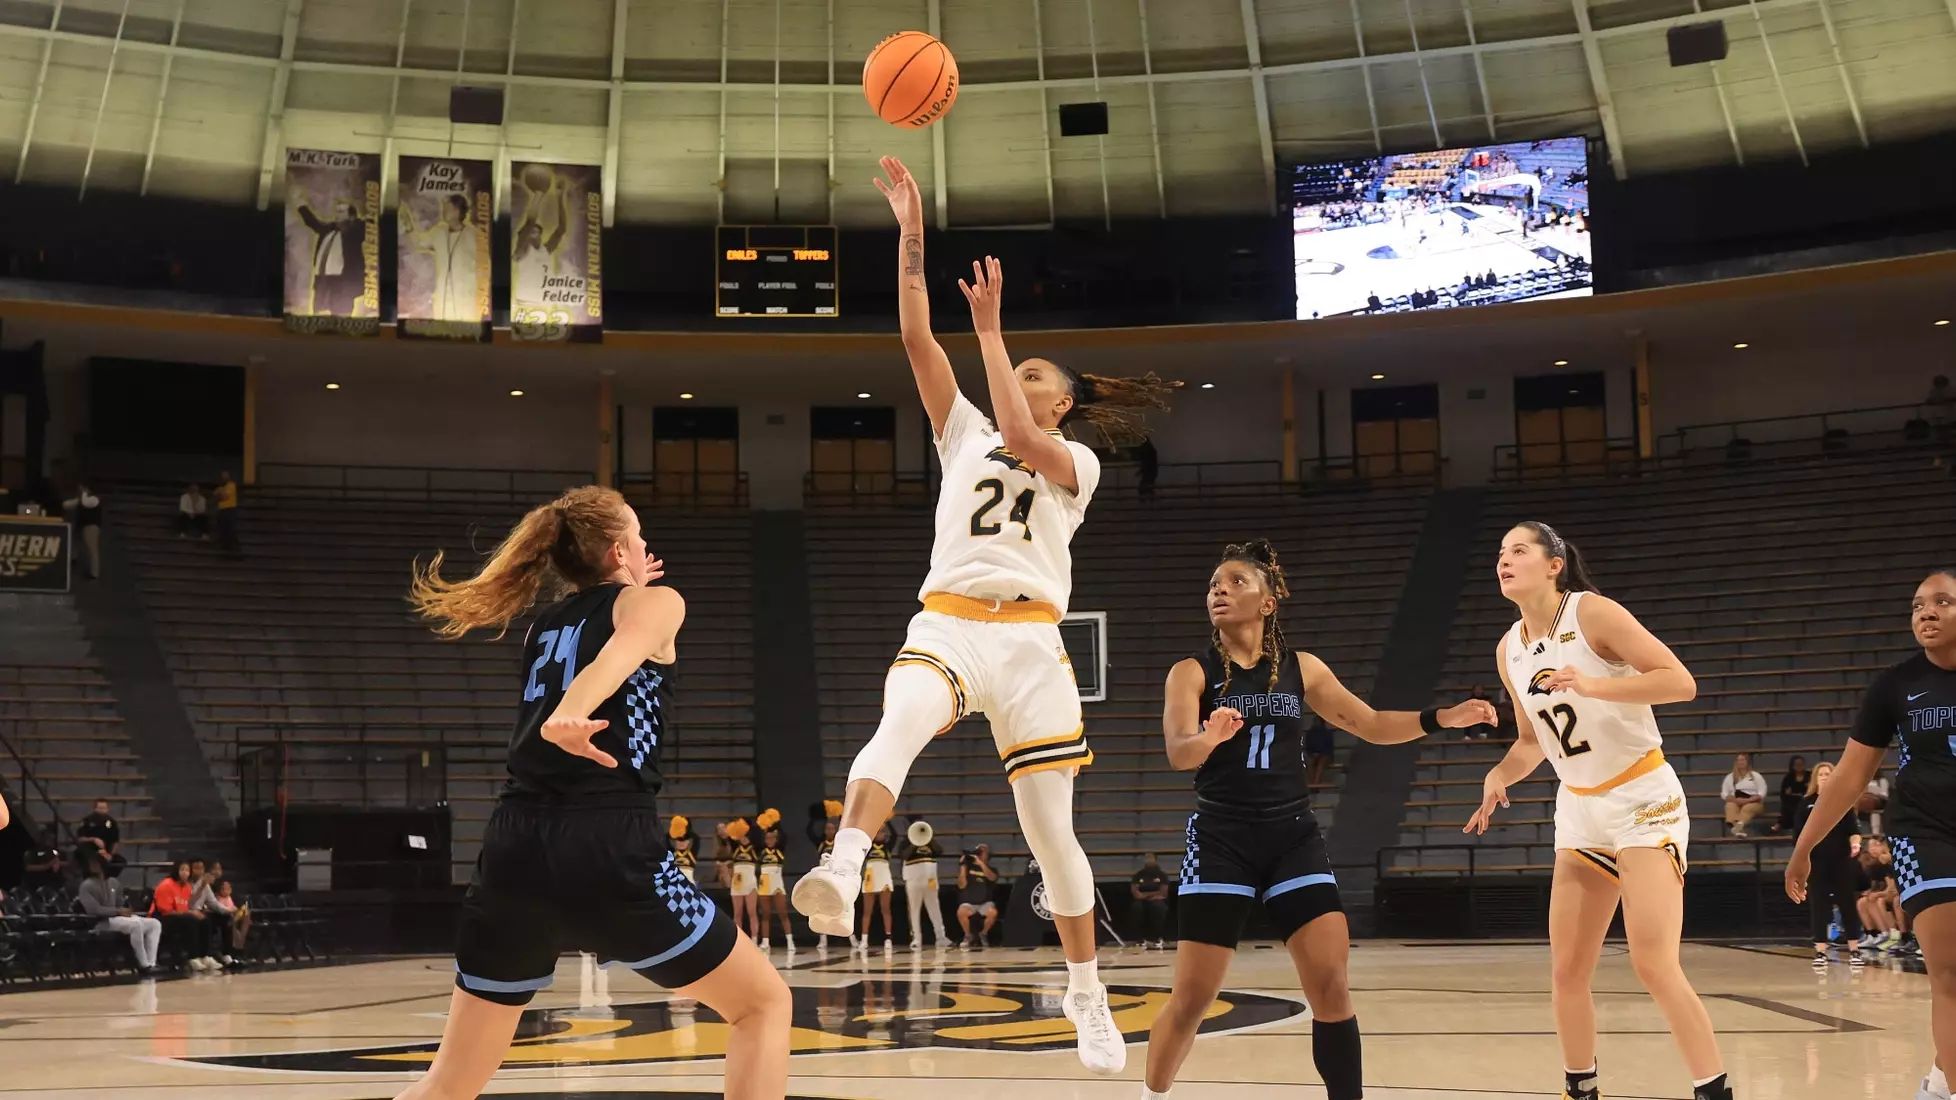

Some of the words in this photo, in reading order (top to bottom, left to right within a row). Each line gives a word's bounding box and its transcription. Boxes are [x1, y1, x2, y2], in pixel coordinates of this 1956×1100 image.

[909, 75, 955, 126] Wilson
[326, 155, 356, 167] Turk
[429, 164, 460, 181] Kay
[420, 178, 465, 193] James
[364, 180, 379, 267] SOUTHERN
[587, 192, 600, 275] SOUTHERN
[726, 249, 758, 261] EAGLES
[793, 249, 830, 261] TOPPERS
[364, 269, 378, 309] MISS
[541, 276, 583, 289] Janice
[542, 291, 584, 303] Felder
[587, 279, 600, 317] MISS
[513, 310, 570, 341] #33
[969, 478, 1036, 542] 24
[523, 618, 587, 702] 24
[1246, 724, 1276, 769] 11
[1537, 703, 1593, 759] 12
